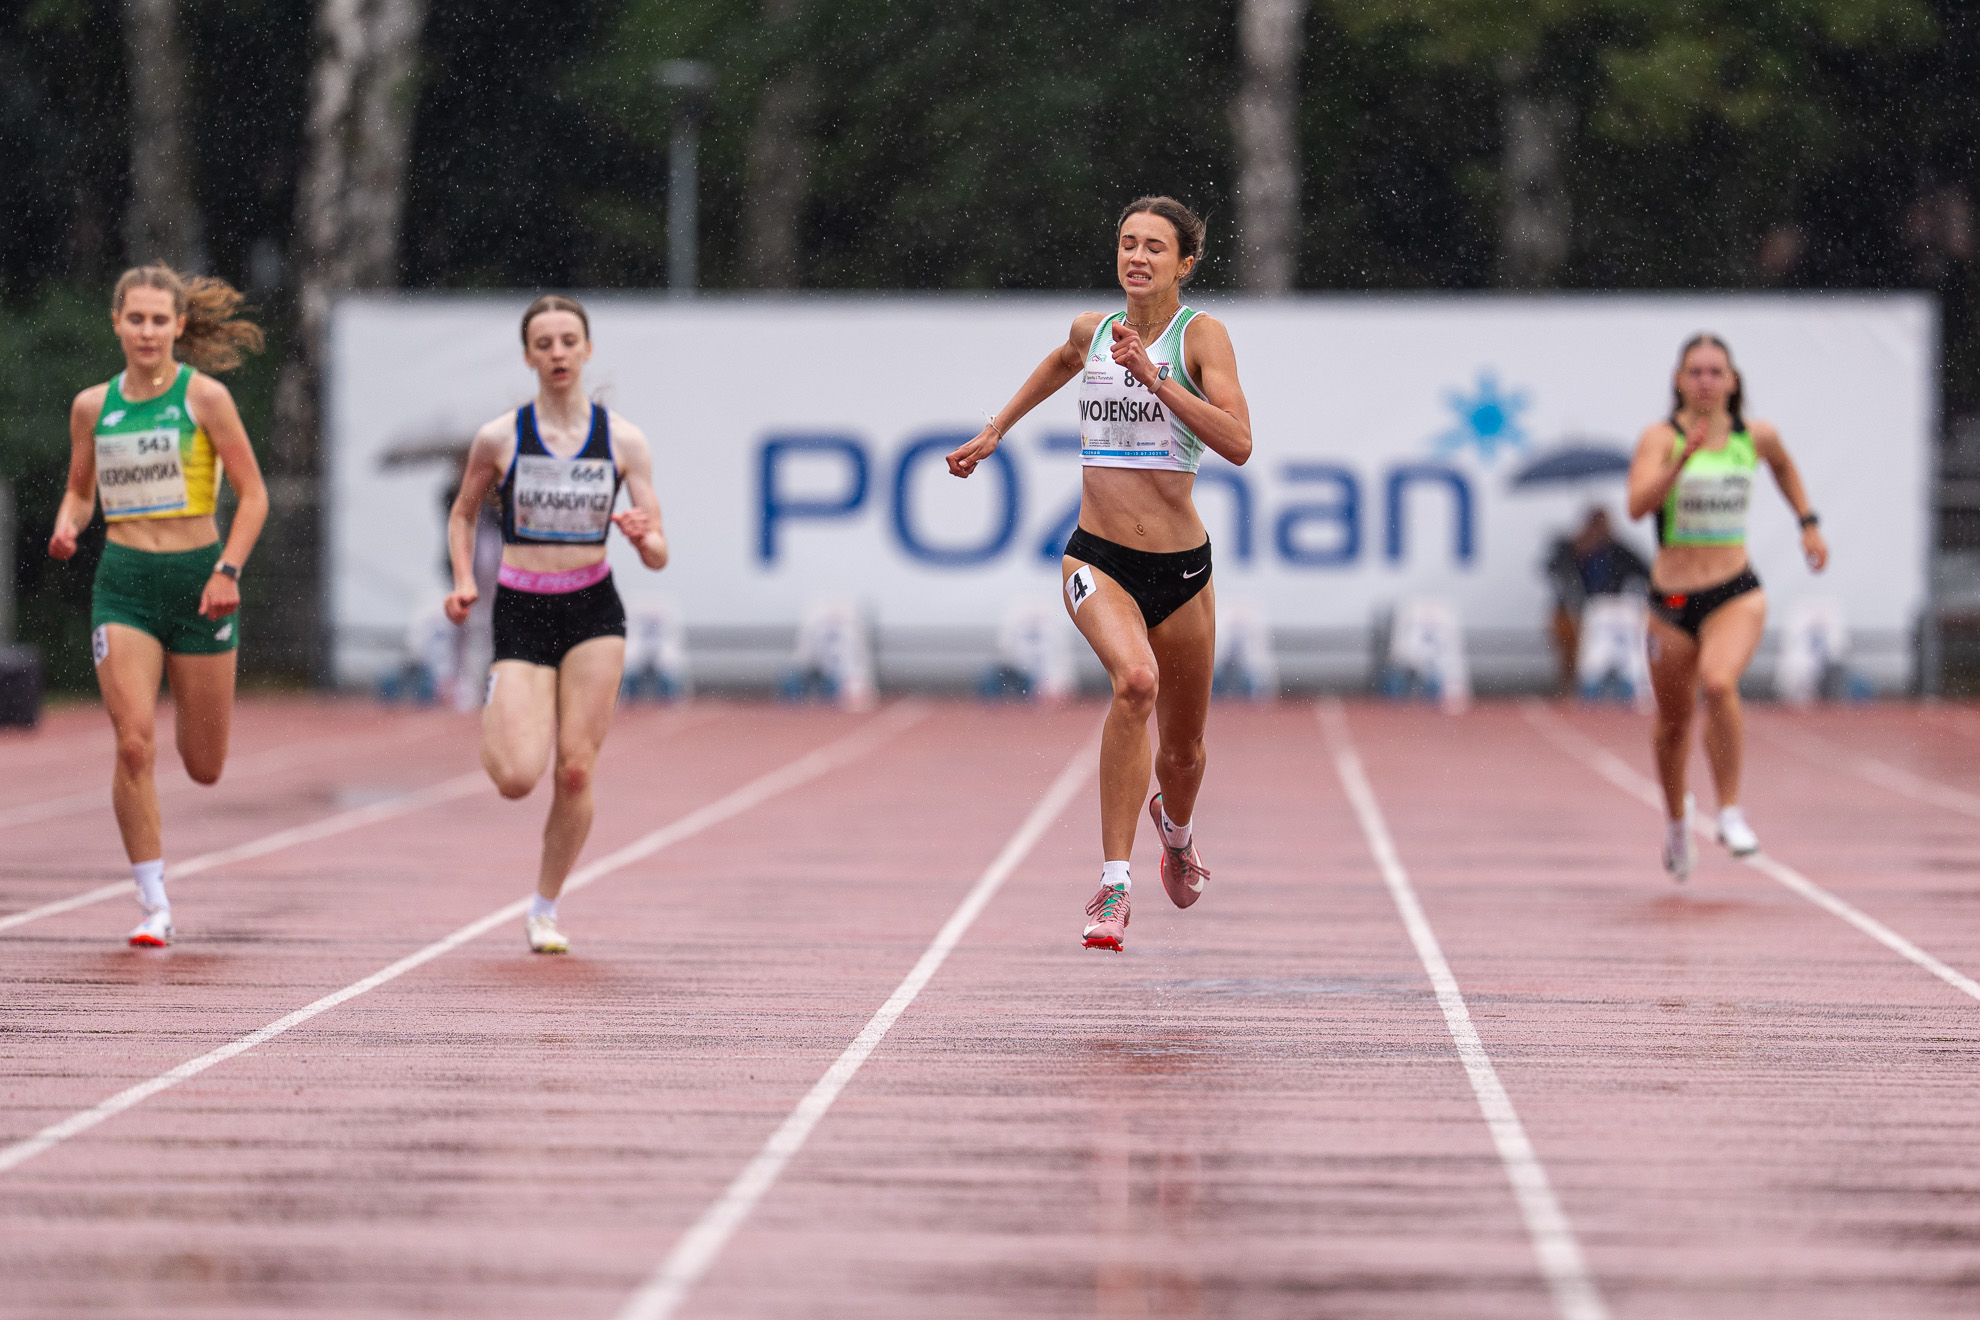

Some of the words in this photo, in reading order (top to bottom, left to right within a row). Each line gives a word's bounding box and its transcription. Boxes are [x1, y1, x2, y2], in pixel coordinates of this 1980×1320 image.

[1079, 396, 1166, 422] WOJEŃSKA
[138, 435, 171, 455] 543
[571, 464, 605, 482] 664
[1073, 572, 1089, 604] 4
